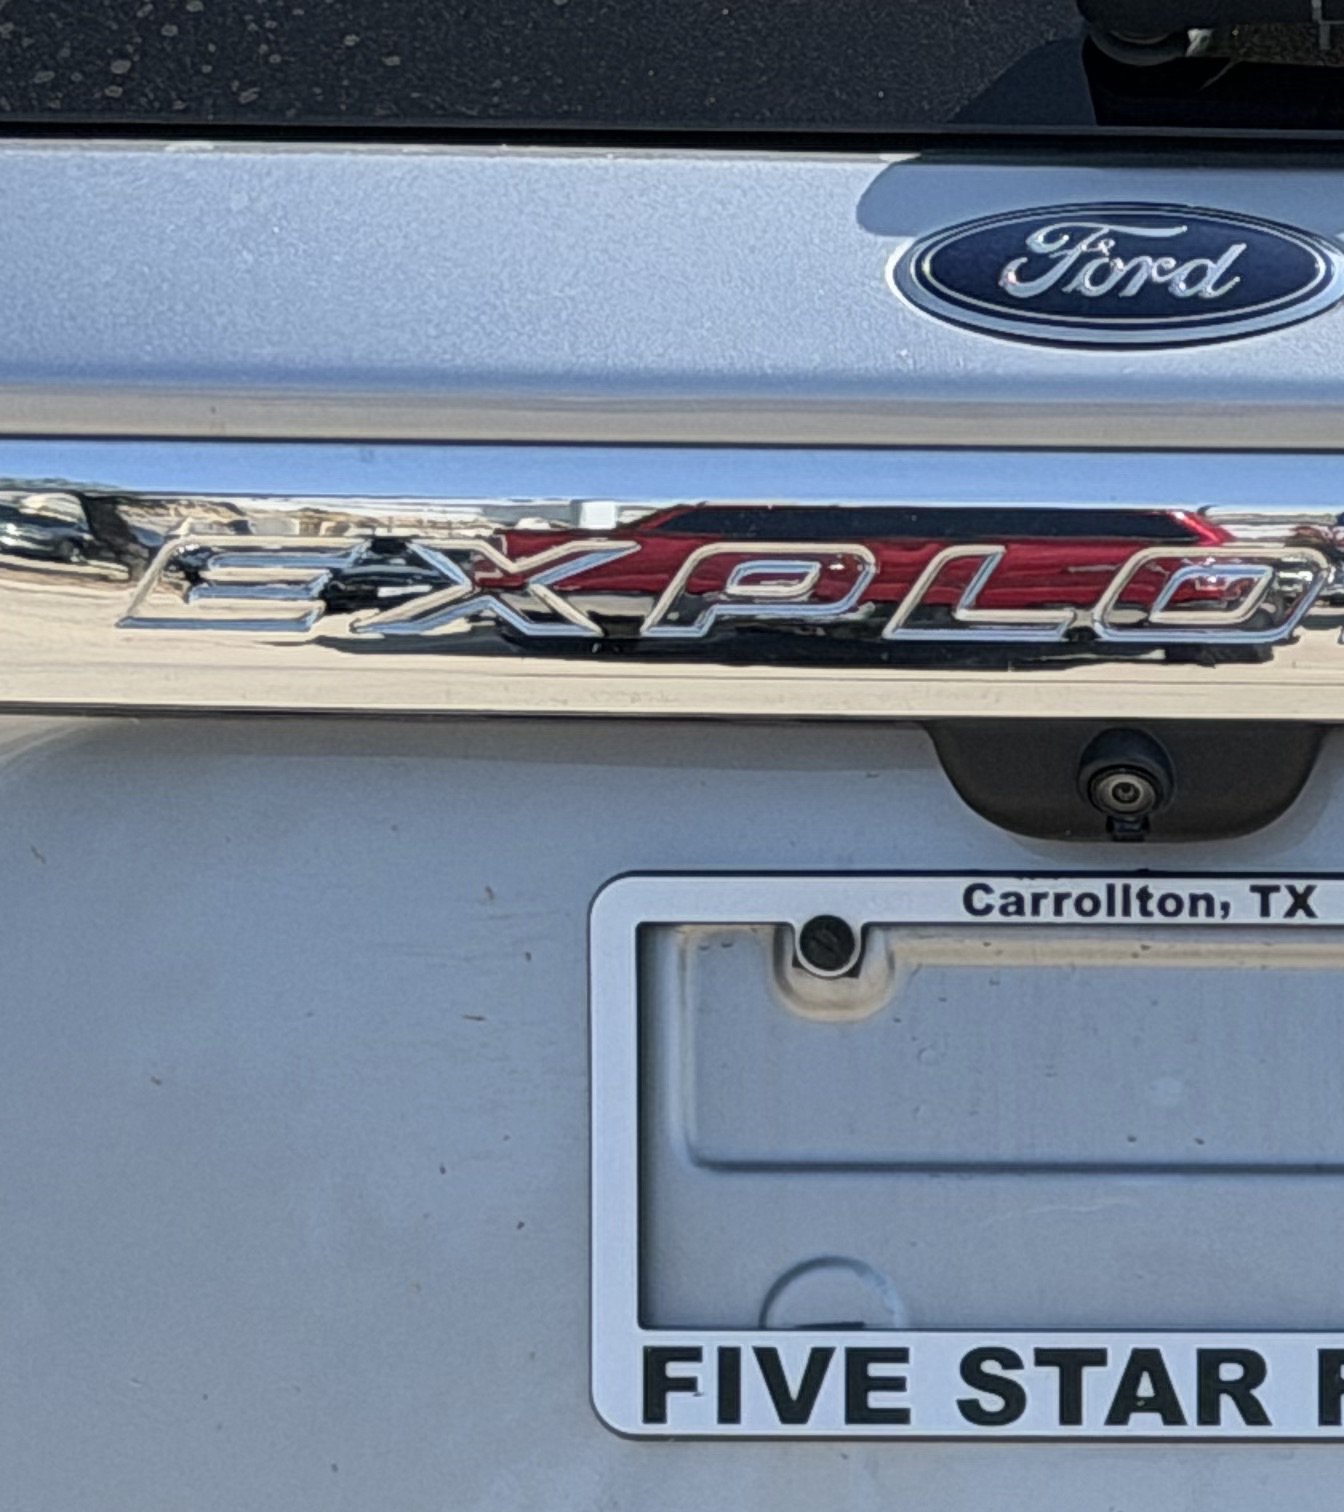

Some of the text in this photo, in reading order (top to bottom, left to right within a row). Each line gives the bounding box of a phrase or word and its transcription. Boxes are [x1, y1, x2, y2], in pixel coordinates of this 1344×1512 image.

[999, 222, 1247, 298] Ford
[962, 882, 1319, 920] Carrollton, TX
[641, 1346, 912, 1426] FIVE
[956, 1344, 1274, 1428] STAR
